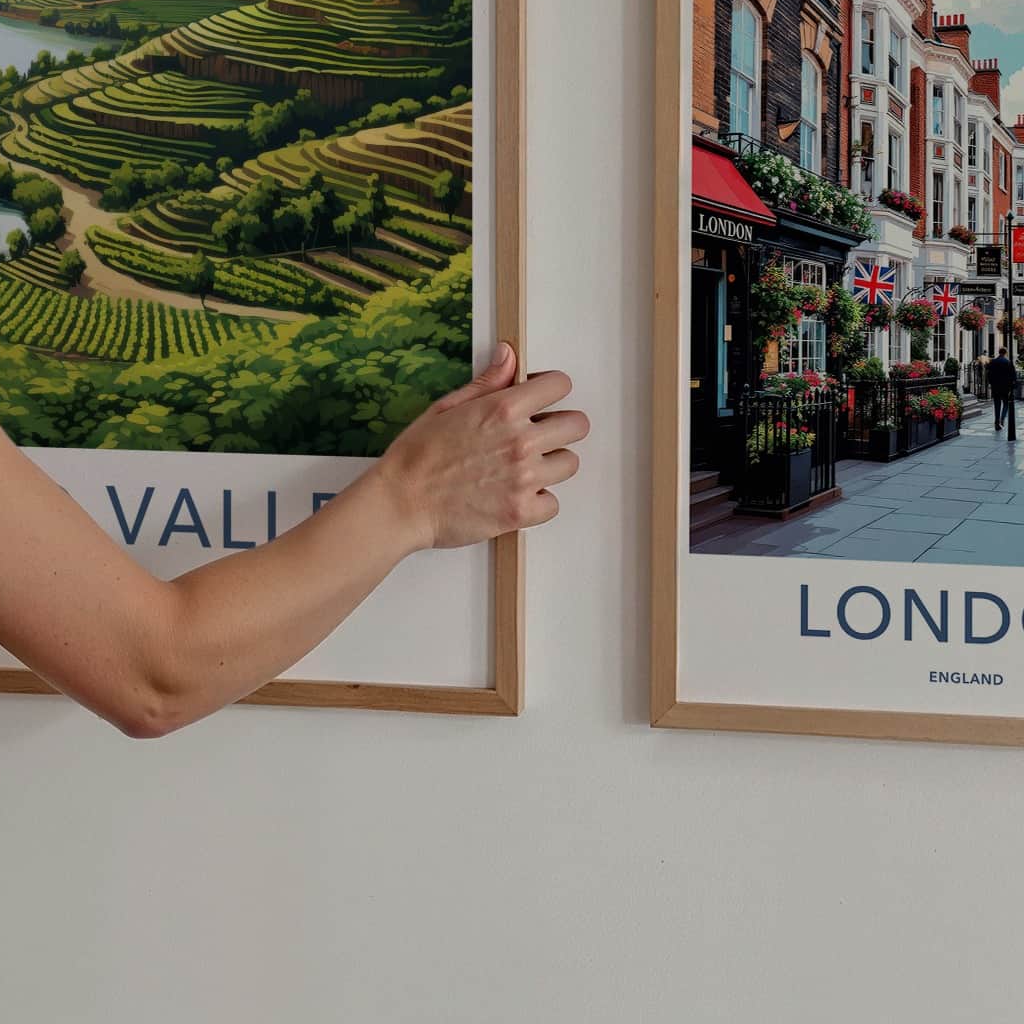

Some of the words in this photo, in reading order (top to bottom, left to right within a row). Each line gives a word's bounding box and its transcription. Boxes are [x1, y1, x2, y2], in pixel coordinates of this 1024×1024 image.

[698, 213, 753, 242] LONDON
[799, 583, 1024, 645] LOND
[929, 670, 1004, 686] ENGLAND
